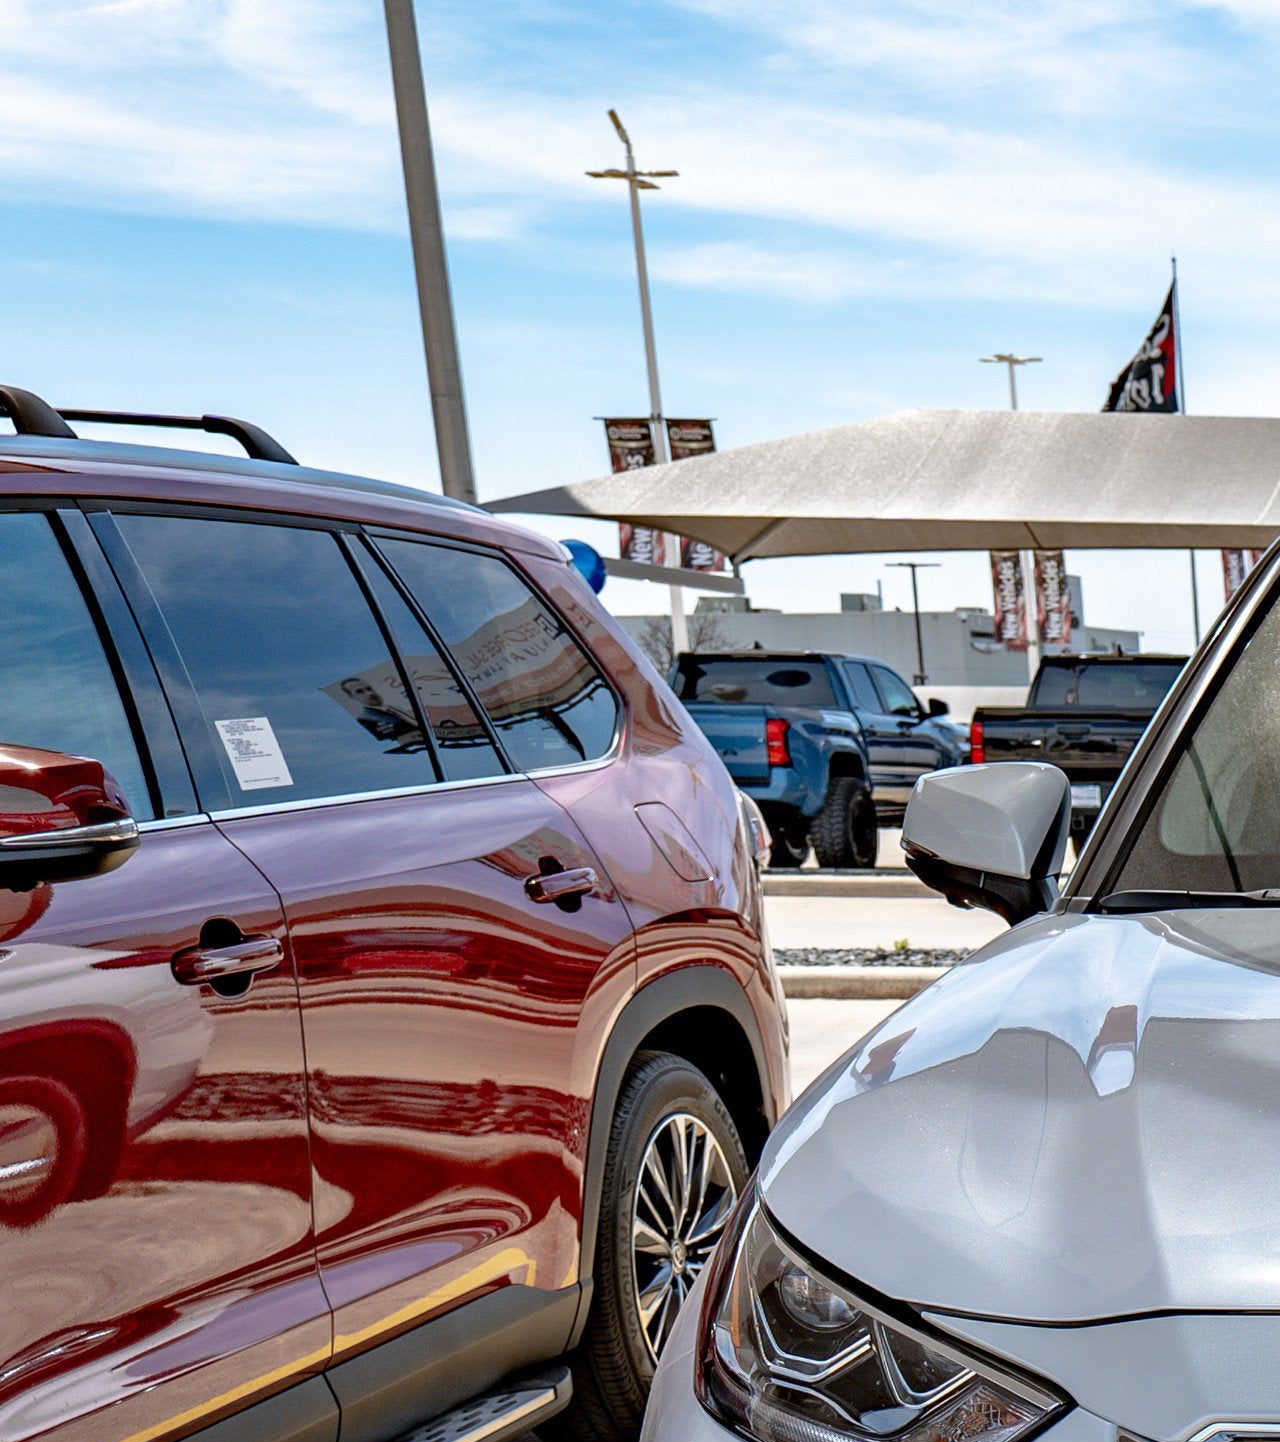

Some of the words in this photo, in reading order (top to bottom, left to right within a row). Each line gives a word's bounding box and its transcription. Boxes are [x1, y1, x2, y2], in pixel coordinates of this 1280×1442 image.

[629, 527, 653, 565] New
[999, 560, 1016, 610] Vehicles
[1041, 560, 1059, 610] Vehicles
[1001, 612, 1019, 639] New
[1044, 611, 1062, 639] New
